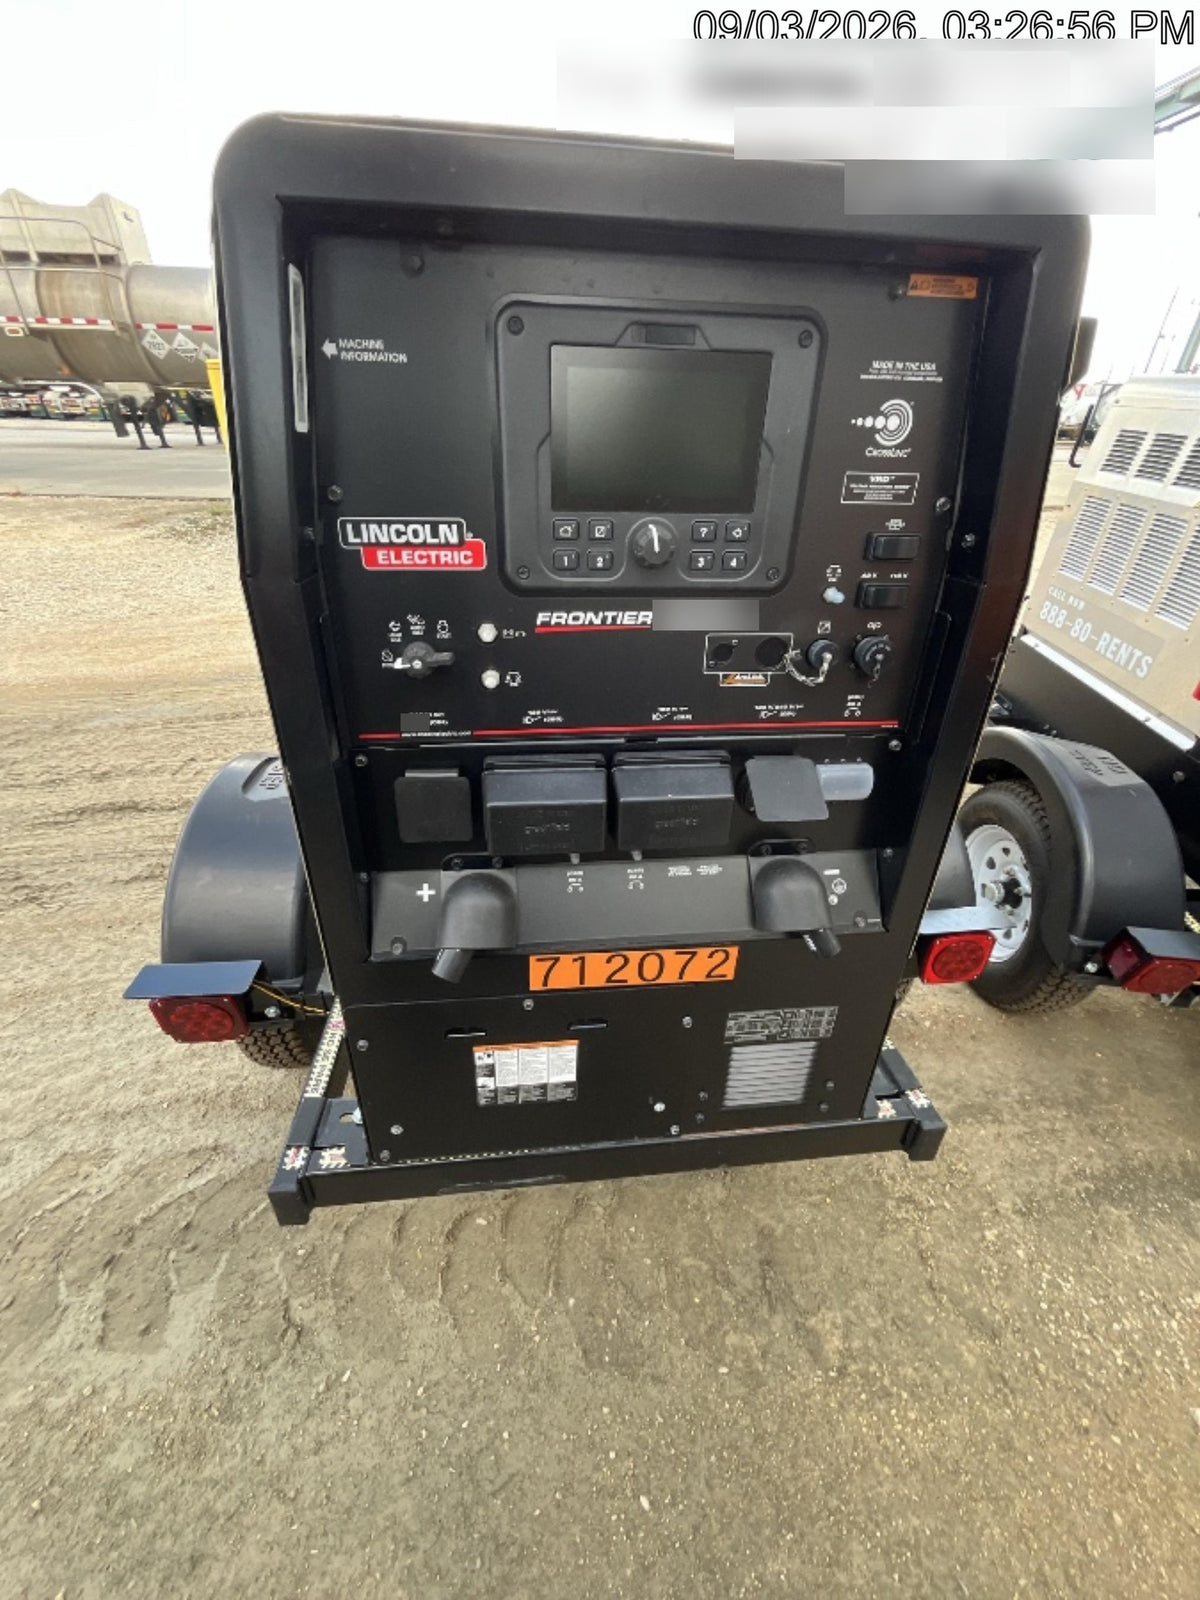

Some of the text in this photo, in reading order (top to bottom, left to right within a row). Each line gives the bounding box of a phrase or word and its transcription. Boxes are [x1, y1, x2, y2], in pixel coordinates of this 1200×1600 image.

[340, 350, 408, 363] INFORMATION
[346, 522, 460, 544] LINCOLN
[376, 550, 474, 565] ELECTRIC
[536, 611, 653, 625] FRONTIER
[1040, 601, 1153, 678] 888-80-RENTS
[535, 949, 731, 988] 712072
